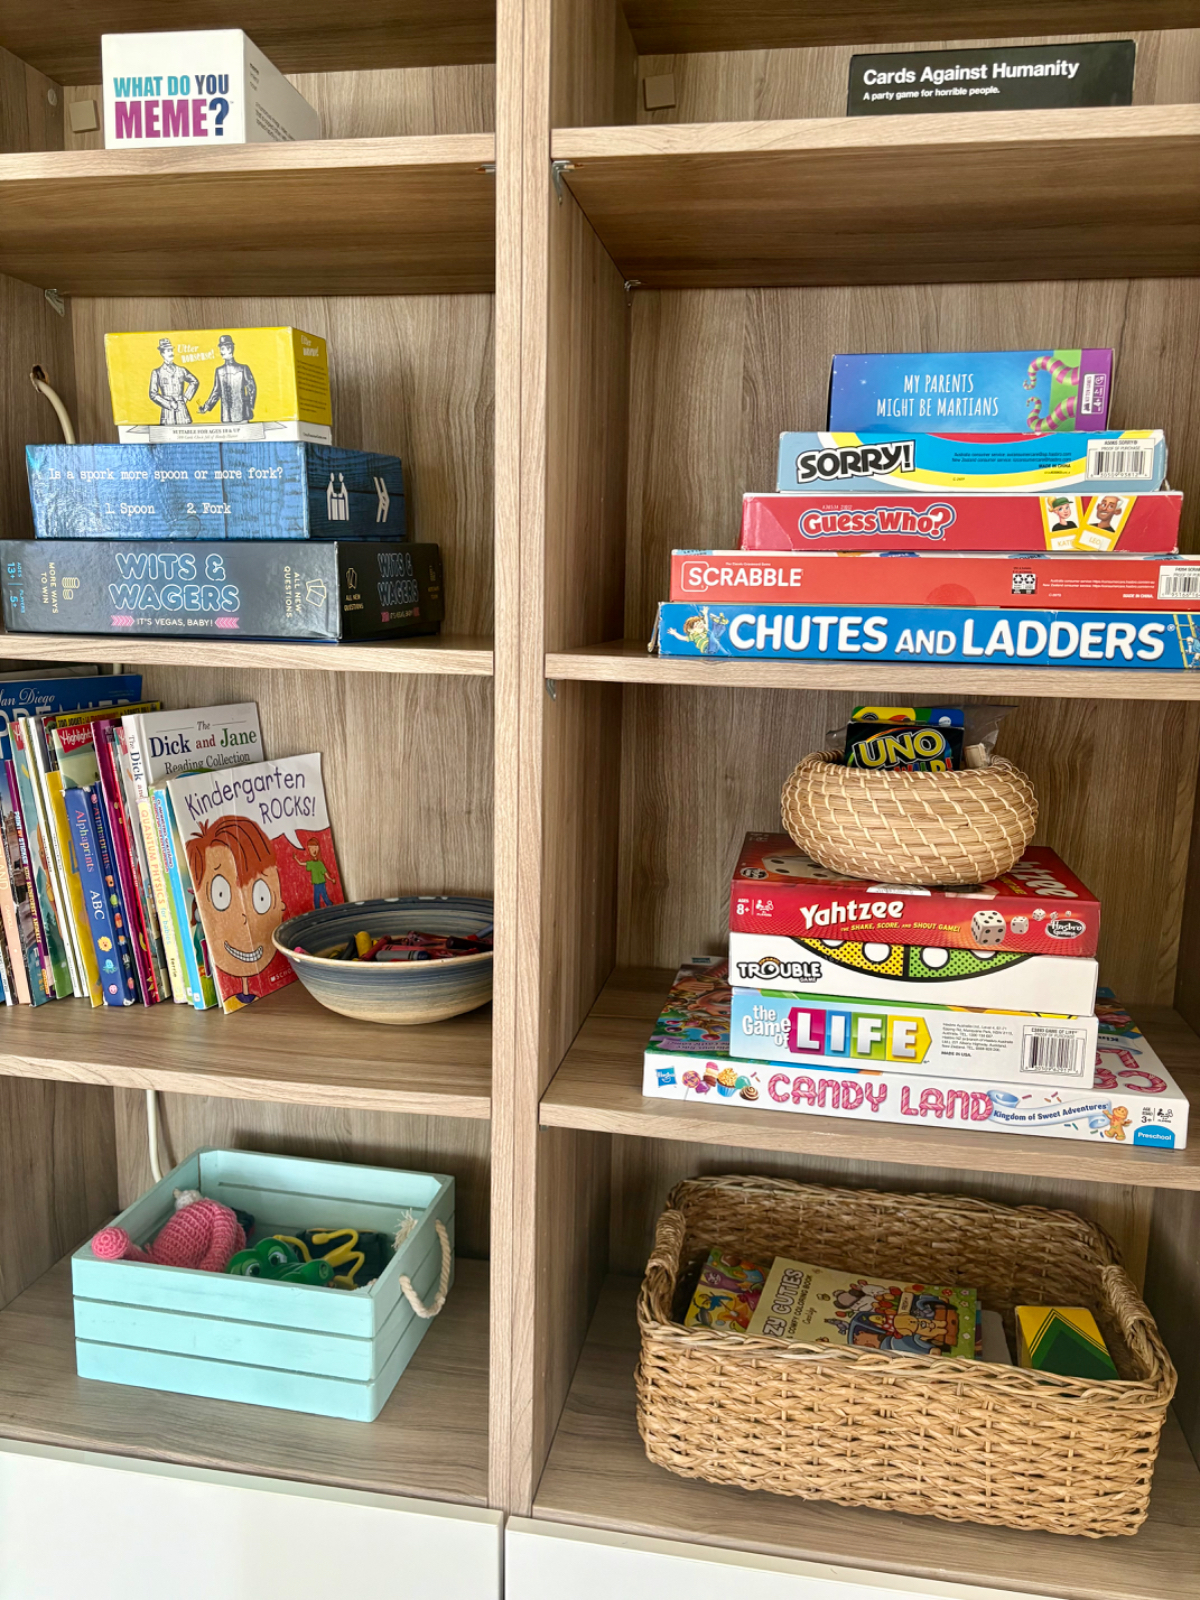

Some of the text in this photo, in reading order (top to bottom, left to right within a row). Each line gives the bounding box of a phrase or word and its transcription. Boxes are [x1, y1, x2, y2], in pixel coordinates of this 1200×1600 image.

[863, 59, 1080, 86] Cards Against Humanity
[113, 76, 163, 98] WHAT
[167, 75, 190, 96] DO
[195, 73, 229, 95] YOU
[863, 86, 1000, 101] A party game for horrible people.
[115, 97, 229, 139] MEME?
[177, 344, 199, 354] Utter
[181, 349, 215, 364] nonsense!
[903, 373, 974, 393] MY PARENTS
[876, 397, 999, 418] MIGHT BE MARTIANS
[799, 442, 913, 482] SORRY!
[50, 467, 284, 484] Is a spork more spoon or more fork?
[120, 502, 155, 517] Spoon
[201, 502, 232, 515] Fork
[1088, 536, 1101, 546] LEO
[7, 562, 16, 579] 13+
[40, 572, 48, 584] TO
[115, 552, 227, 582] WITS &
[688, 566, 802, 587] SCRABBLE
[48, 562, 59, 614] MORE WAYS
[108, 583, 241, 612] WAGERS
[283, 565, 293, 619] QUESTIONS
[293, 572, 302, 613] ALL NEW
[137, 617, 214, 628] IT'S VEGAS, BABY!
[728, 612, 1164, 662] CHUTES AND LADDERS
[19, 687, 56, 707] Diego
[197, 720, 211, 730] The
[148, 728, 258, 758] Dick and Jane
[856, 730, 945, 768] UNO
[130, 751, 144, 782] Dick
[164, 751, 251, 775] Reading Collection
[184, 767, 306, 822] Kindergarten
[259, 795, 317, 825] ROCKS!
[74, 809, 106, 920] Alphaprints ABC
[140, 809, 158, 862] QUANTUM
[151, 862, 167, 904] PHYSICS
[162, 919, 172, 945] babies
[736, 903, 751, 915] 8+
[800, 899, 904, 931] Yahtzee
[851, 923, 875, 931] SHAKE,
[877, 921, 900, 930] SCORE,
[913, 921, 937, 931] SHOUT
[937, 923, 961, 933] GAME!
[1051, 919, 1083, 932] Hasbro
[738, 959, 821, 980] TROUBLE
[753, 1004, 778, 1022] the
[742, 1014, 792, 1039] Game
[797, 1011, 917, 1058] LIFE
[774, 1030, 791, 1049] of
[768, 1072, 994, 1121] CANDY LAND
[993, 1101, 1108, 1121] Kingdom of Sweet Adventures
[1141, 1115, 1152, 1124] 3+
[1137, 1131, 1172, 1141] Preschool
[771, 1267, 805, 1315] CUTIES
[793, 1274, 813, 1317] COLORING BOOK
